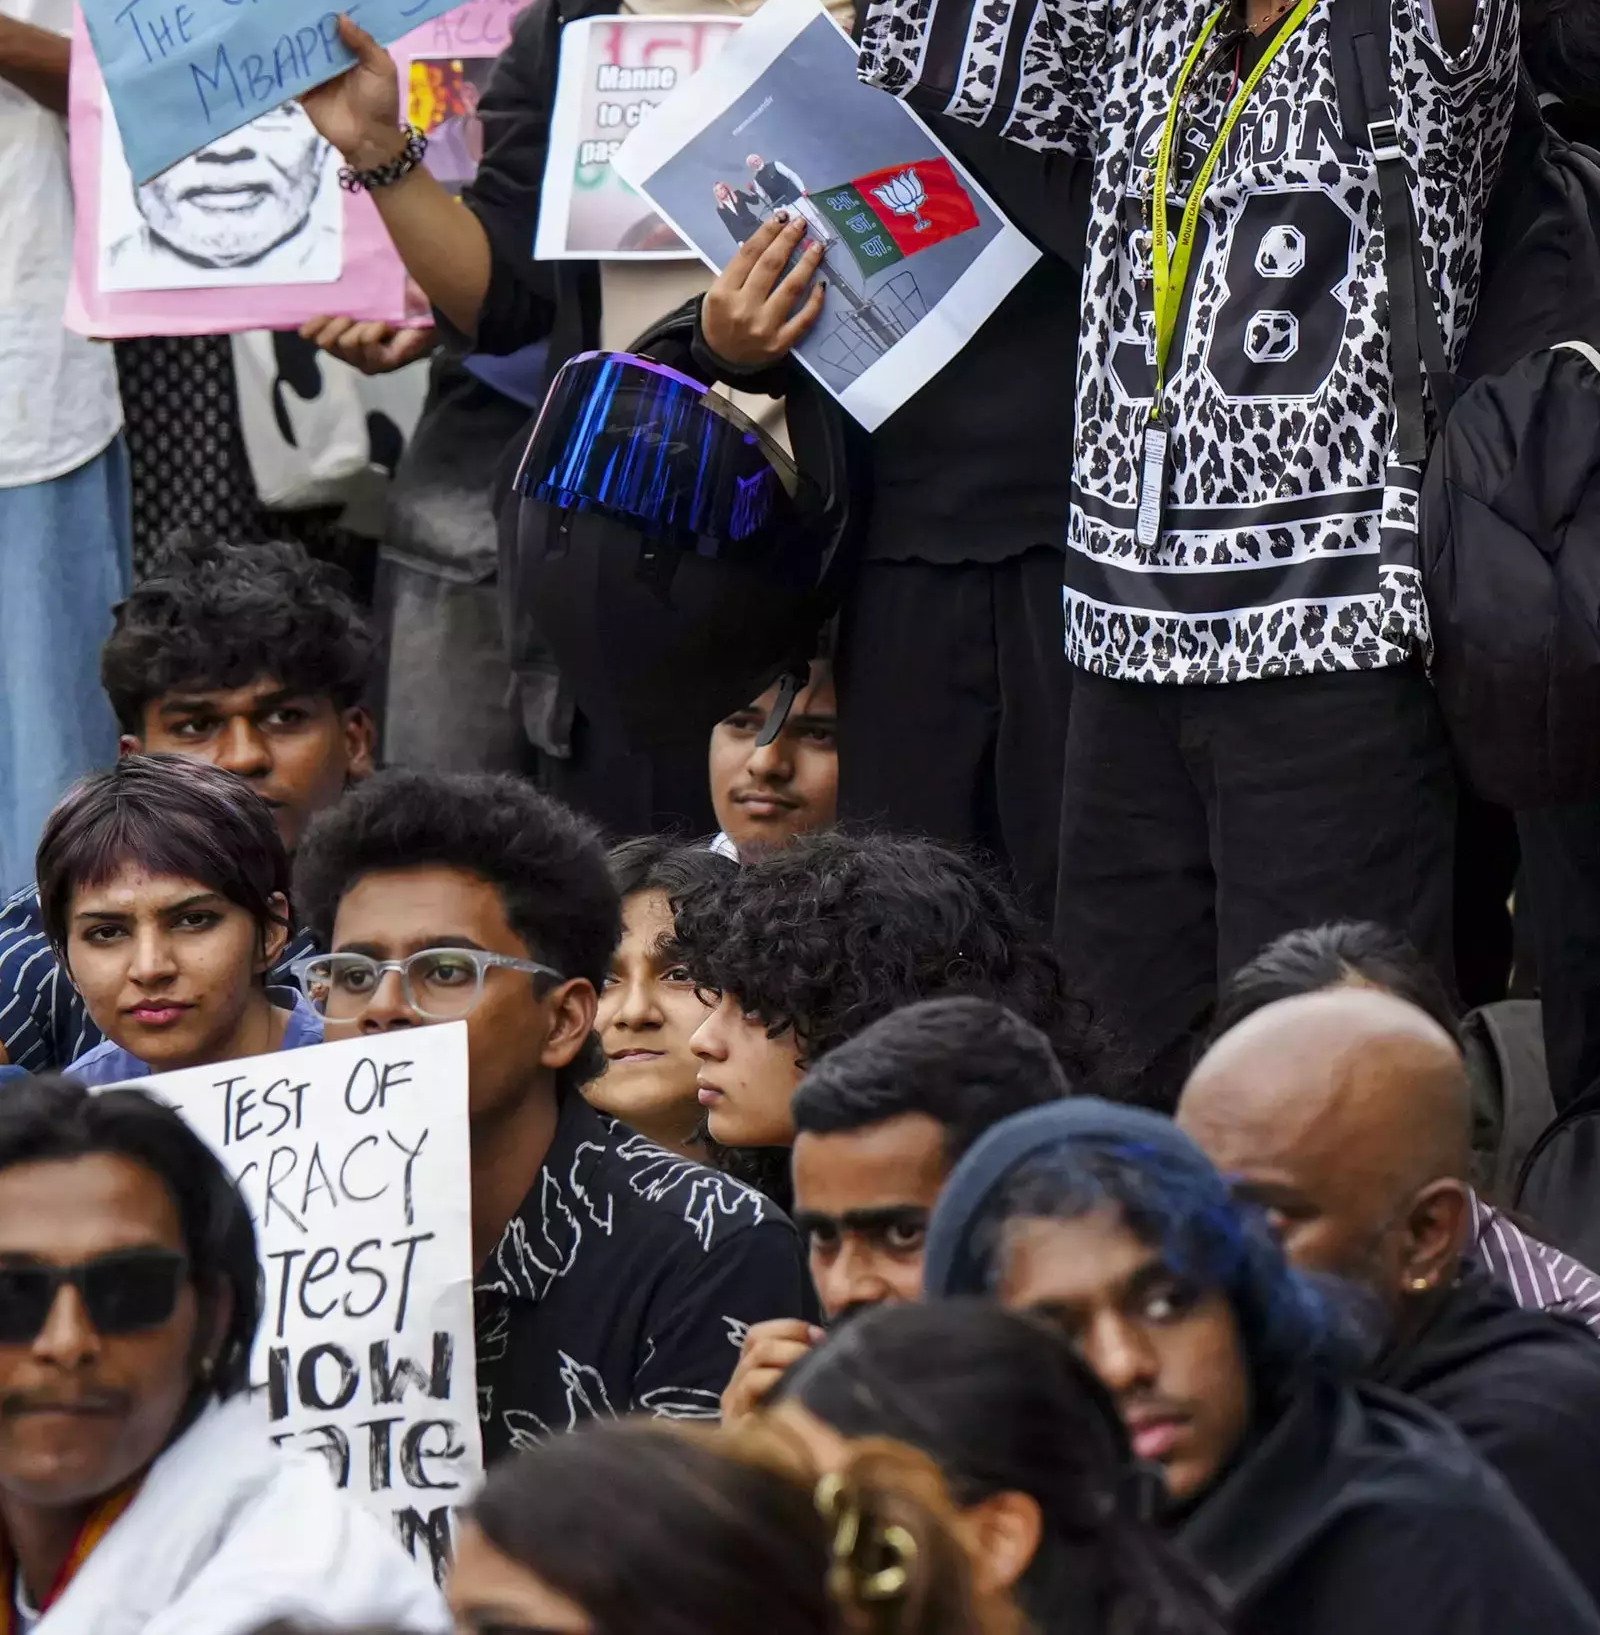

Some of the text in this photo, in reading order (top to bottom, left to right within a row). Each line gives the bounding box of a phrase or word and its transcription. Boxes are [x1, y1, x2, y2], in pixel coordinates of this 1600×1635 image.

[597, 63, 677, 92] Manne
[596, 101, 623, 128] to
[1157, 188, 1166, 218] CARMEL
[1181, 217, 1196, 246] MOUNT
[1189, 187, 1203, 218] CARMEL
[1156, 218, 1164, 246] MOUNT
[211, 1056, 415, 1147] TEST OF
